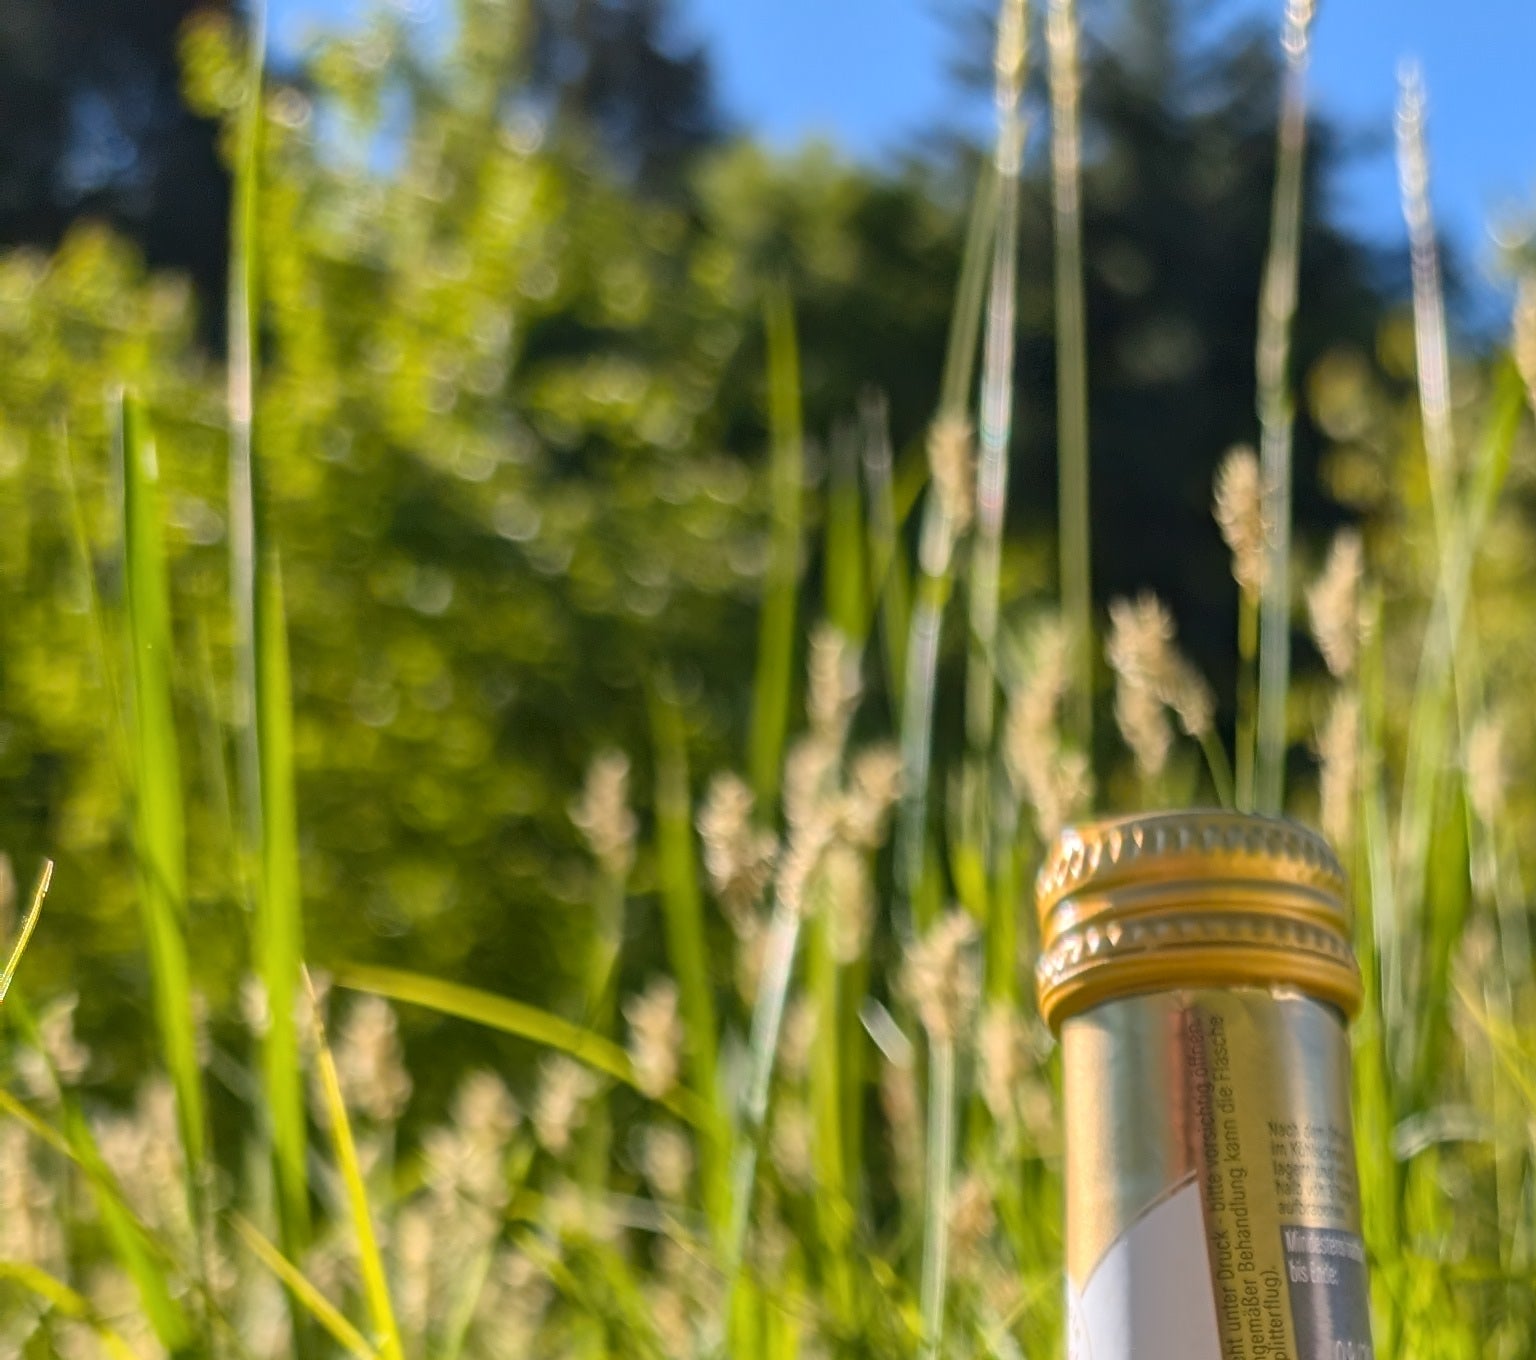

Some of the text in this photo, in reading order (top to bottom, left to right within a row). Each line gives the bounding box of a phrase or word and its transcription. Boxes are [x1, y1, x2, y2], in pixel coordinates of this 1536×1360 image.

[1210, 1016, 1231, 1081] Flasche
[1216, 1087, 1234, 1114] die
[1195, 1083, 1220, 1166] vorsichtig
[1223, 1119, 1241, 1162] kann
[1207, 1174, 1226, 1211] bitte
[1228, 1168, 1255, 1272] Behandlung
[1212, 1230, 1235, 1280] Druck
[1221, 1287, 1241, 1331] unter
